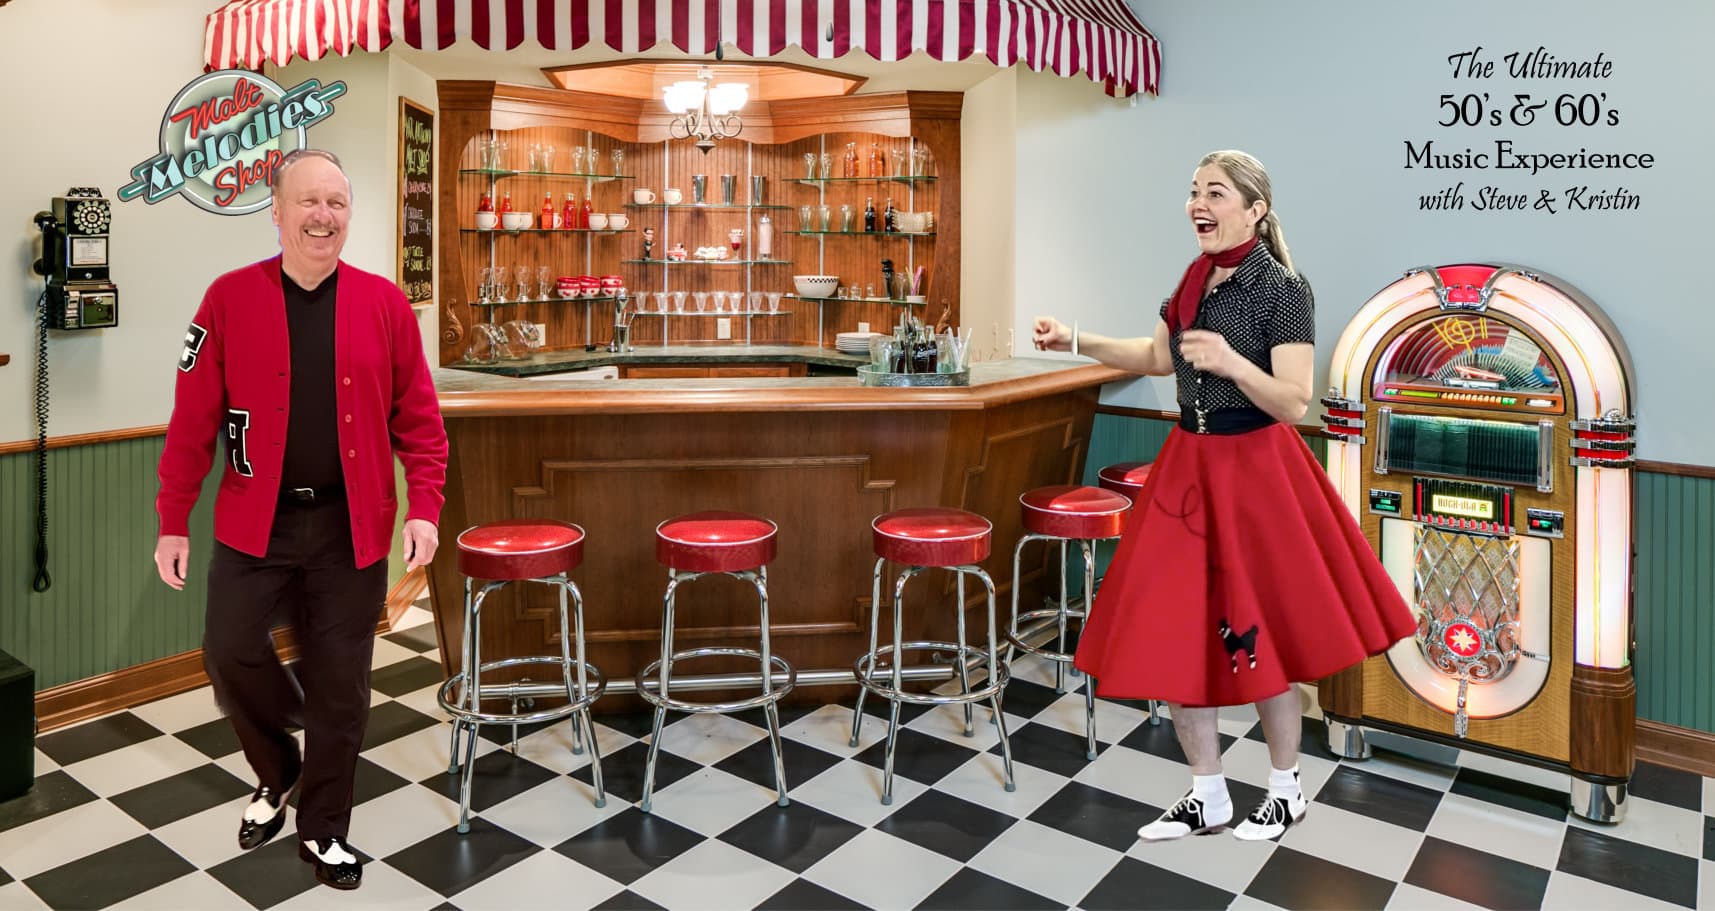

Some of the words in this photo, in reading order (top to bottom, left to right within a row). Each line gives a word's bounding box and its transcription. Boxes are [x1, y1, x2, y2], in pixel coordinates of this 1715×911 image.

[170, 78, 264, 139] Malt
[150, 91, 324, 199] Melodies
[214, 149, 284, 206] Shop
